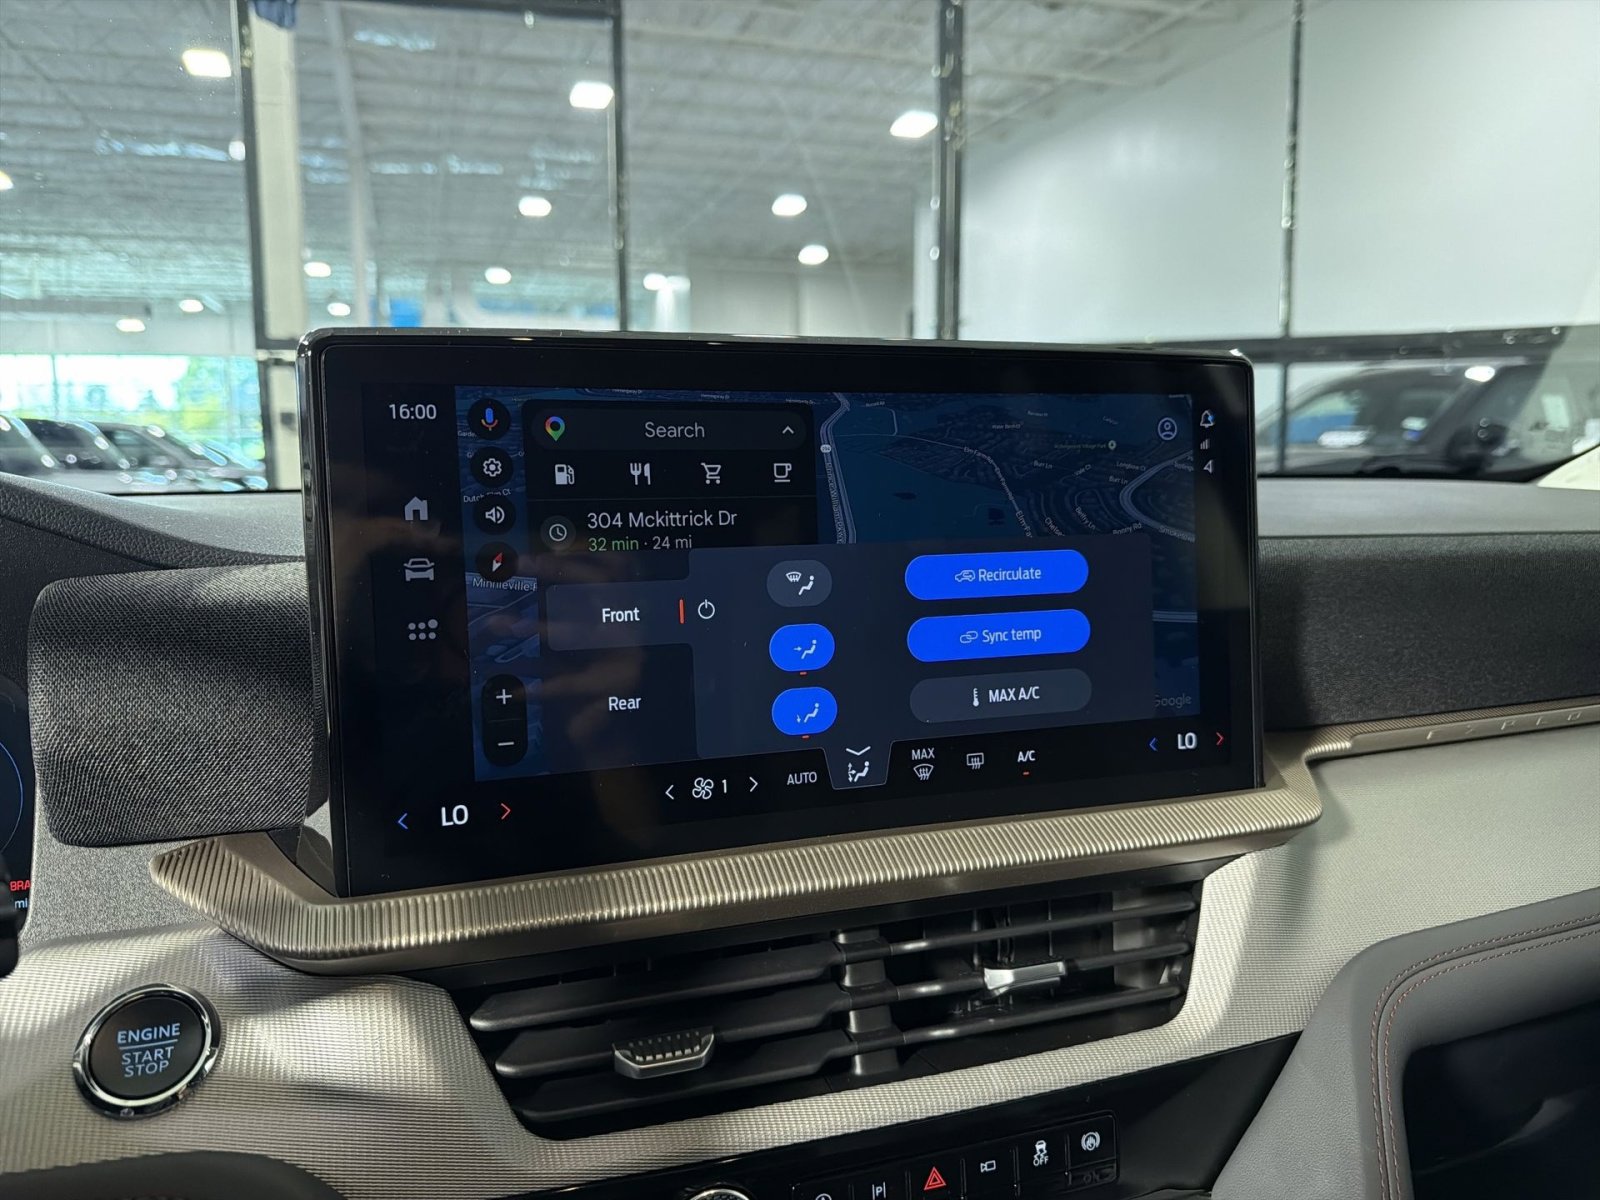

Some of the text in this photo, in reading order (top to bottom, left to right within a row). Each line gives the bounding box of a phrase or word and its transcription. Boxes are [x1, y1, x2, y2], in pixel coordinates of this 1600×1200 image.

[389, 403, 437, 420] 16:00
[644, 421, 705, 438] Search
[587, 509, 738, 529] 304 Mckittrick Dr
[588, 534, 693, 552] 32 min 24 mi
[978, 566, 1042, 582] Recirculate
[601, 607, 641, 623] Front
[981, 627, 1042, 645] Sync temp
[988, 685, 1041, 703] MAX A/C
[607, 696, 641, 711] Rear
[1177, 732, 1198, 750] LO
[911, 747, 935, 760] MAX
[1017, 750, 1036, 763] A/C
[721, 779, 728, 794] 1
[786, 771, 818, 785] AUTO
[440, 804, 469, 826] LO
[117, 1022, 181, 1044] ENGINE
[121, 1046, 175, 1065] START
[124, 1060, 169, 1078] STOP
[1033, 1155, 1049, 1167] OFF
